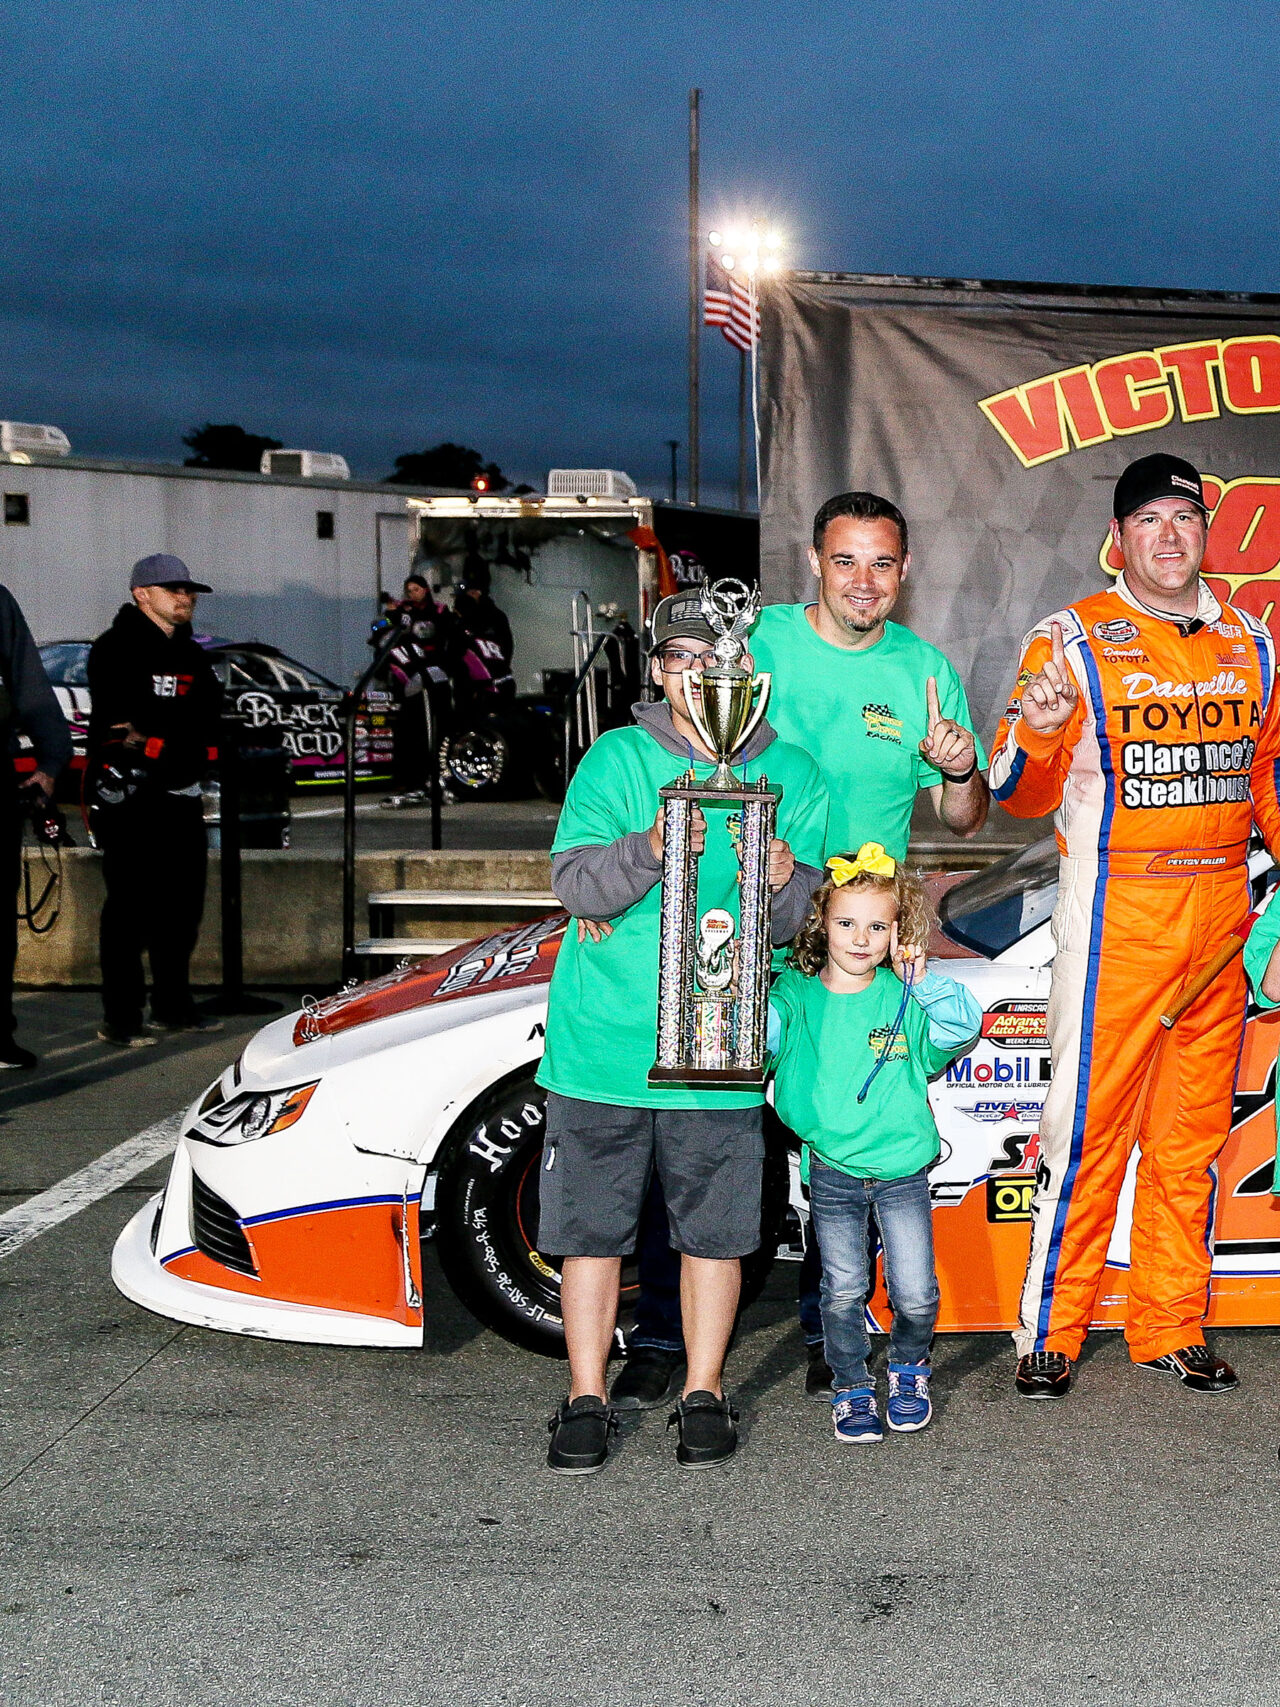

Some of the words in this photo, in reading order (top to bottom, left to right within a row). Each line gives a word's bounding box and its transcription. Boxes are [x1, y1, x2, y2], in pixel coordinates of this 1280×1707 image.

[1102, 654, 1150, 664] TOYOTA
[1122, 671, 1247, 700] Danville
[1113, 700, 1260, 733] TOYOTA
[1016, 1004, 1047, 1012] NASCAR
[993, 1015, 1046, 1026] Advance
[987, 1025, 1014, 1035] Auto
[1014, 1025, 1043, 1035] Parts
[946, 1057, 1030, 1082] Mobil
[974, 1102, 1012, 1112] FIVE
